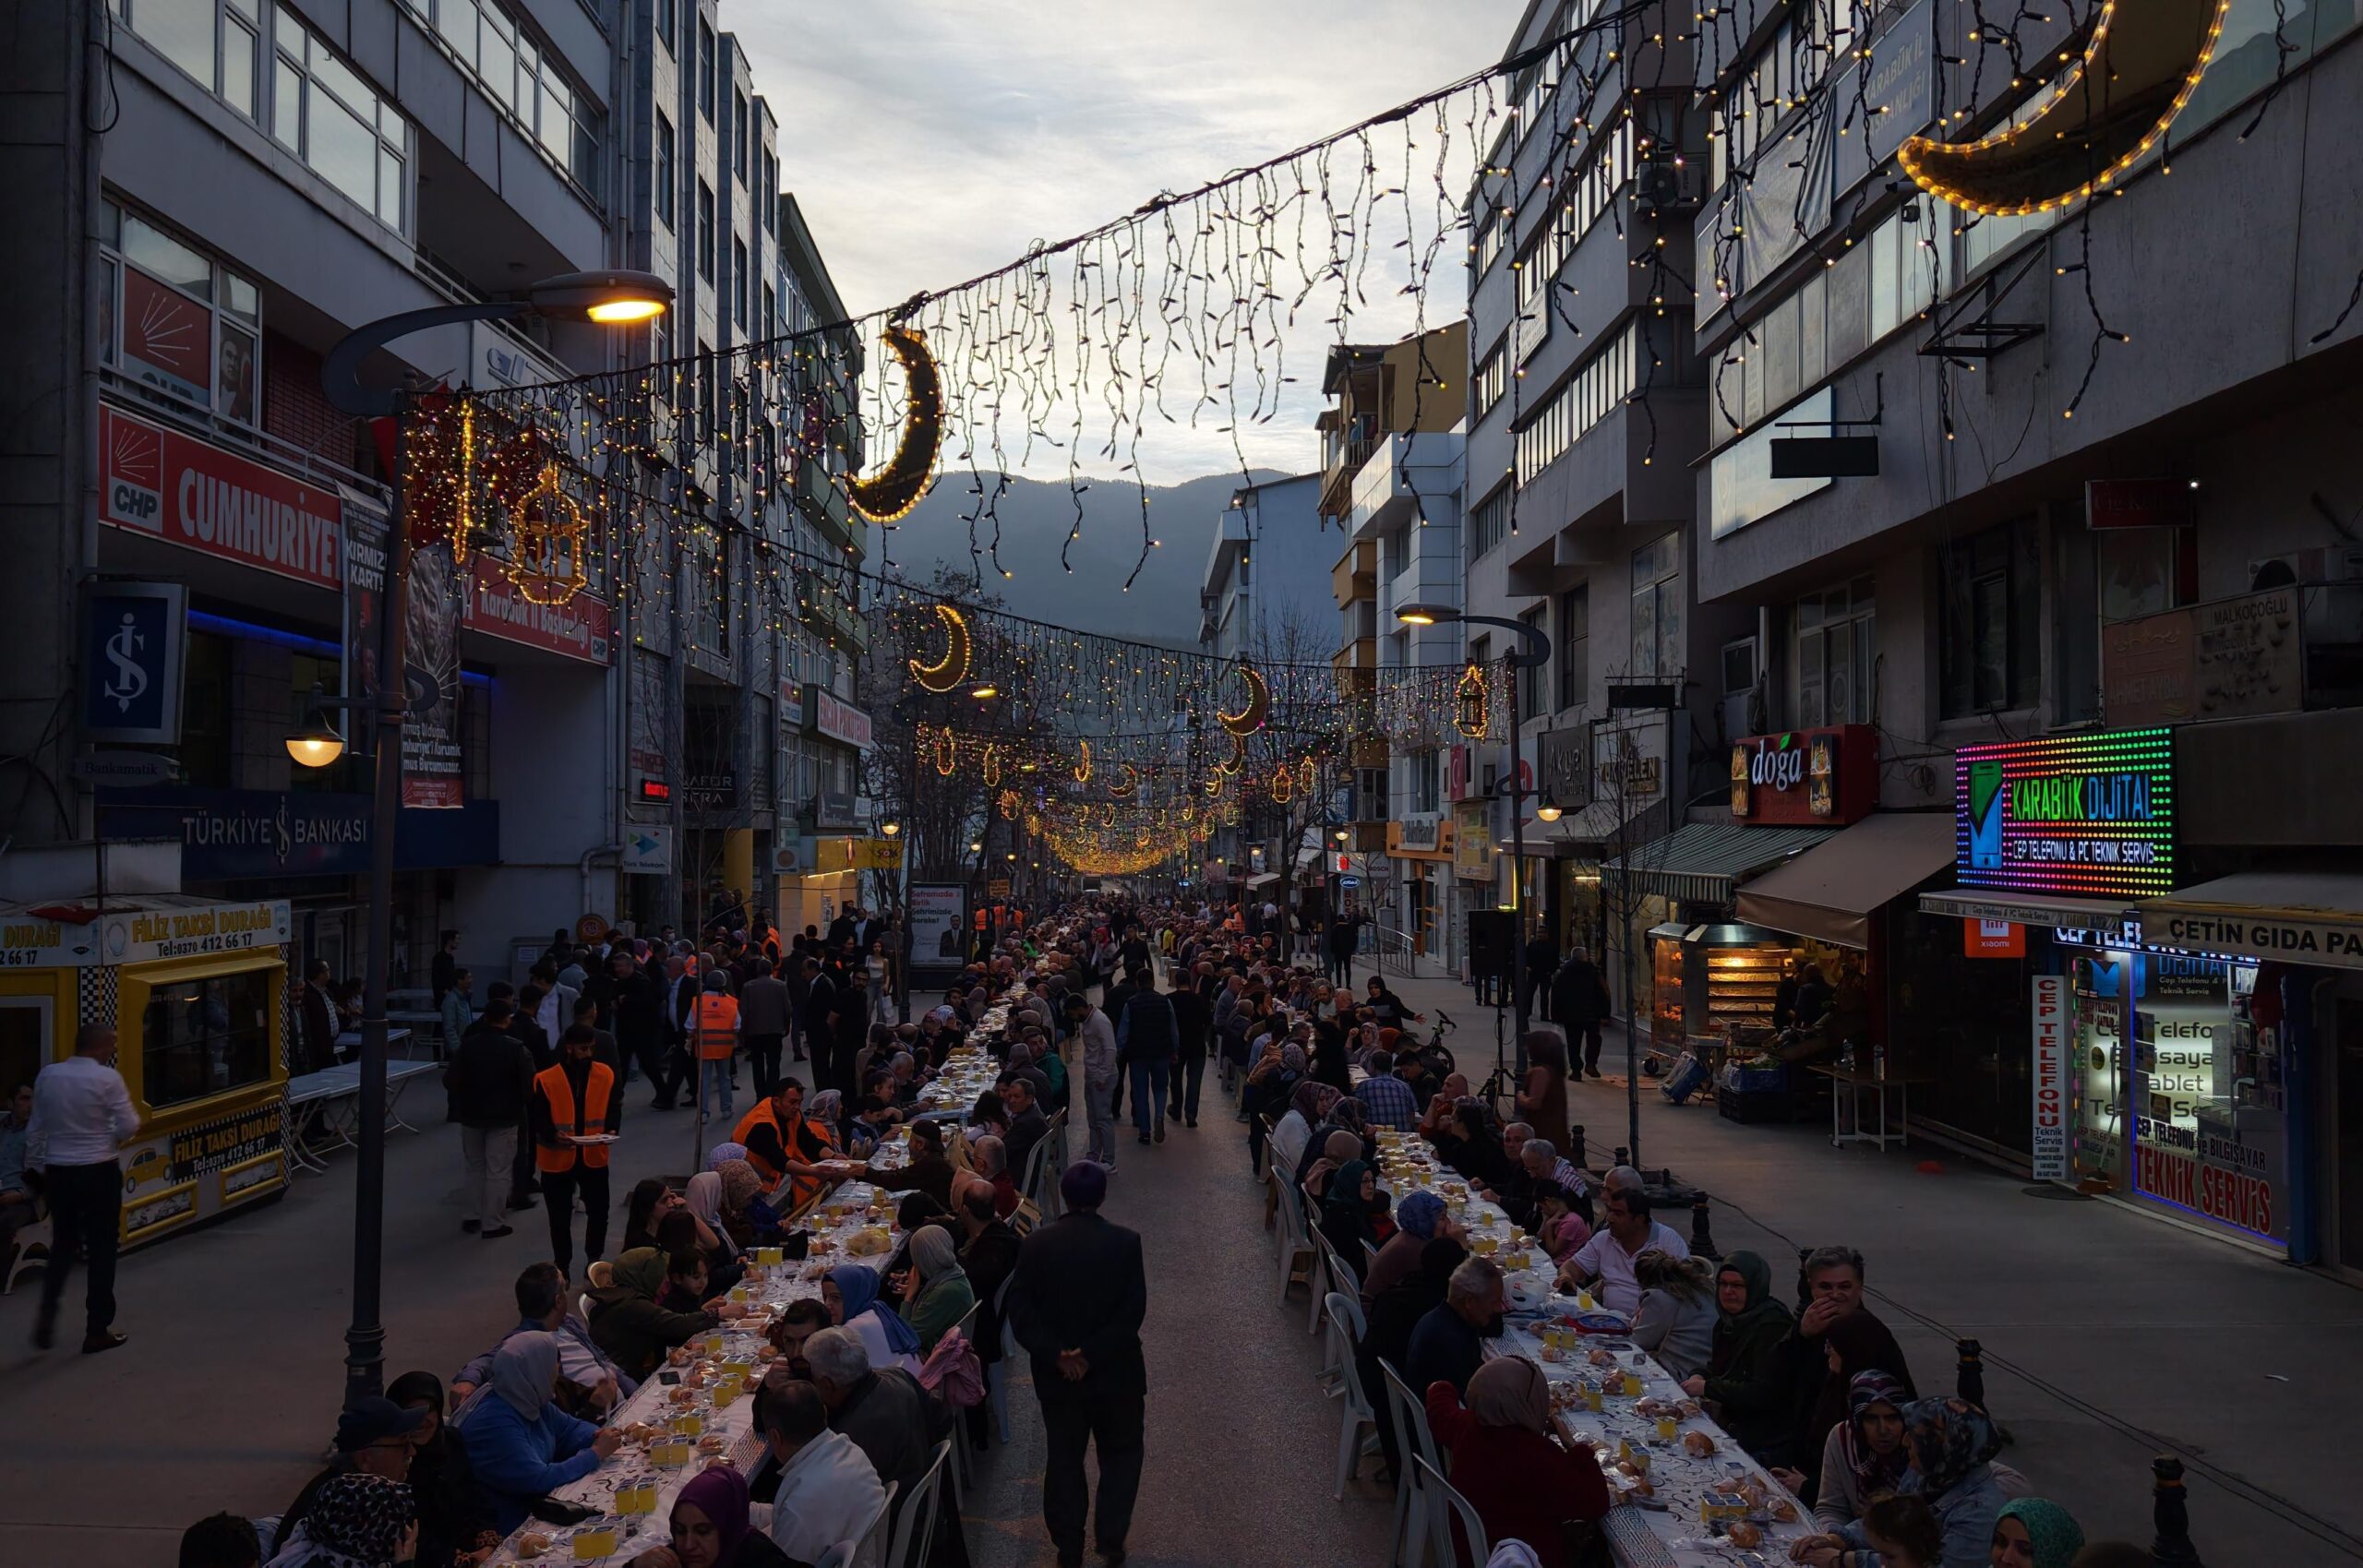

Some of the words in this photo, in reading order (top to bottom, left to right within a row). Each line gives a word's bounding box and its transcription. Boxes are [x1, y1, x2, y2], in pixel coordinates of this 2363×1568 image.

[114, 485, 157, 519] CHP
[178, 467, 342, 581] CUMHURİYET
[351, 564, 383, 593] KART!
[85, 762, 158, 776] Bankamatik
[1550, 738, 1585, 781] Akyel
[2013, 774, 2084, 820] KARABÜK
[2088, 774, 2154, 820] DİJİTAL
[183, 810, 271, 845] TÜRKİYE
[294, 818, 366, 844] BANKASI
[2013, 840, 2027, 859] CEP
[2029, 840, 2067, 860] TELEFONU
[2069, 841, 2075, 860] &
[2078, 841, 2089, 861] PC
[2091, 841, 2119, 862] TEKNİK
[2122, 842, 2154, 864] SERVİS
[132, 913, 170, 943] FİLİZ
[174, 908, 215, 939] TAKSİ
[220, 903, 271, 934] DURAĞI
[2170, 918, 2243, 944] ÇETİN
[2250, 926, 2318, 952] GIDA
[200, 936, 222, 952] 412
[225, 934, 238, 948] 66
[242, 932, 253, 946] 17
[1980, 940, 2009, 948] xiaomi
[8, 951, 22, 965] 66
[25, 950, 38, 964] 17
[2159, 987, 2184, 995] Teknik
[2177, 976, 2209, 985] Telefonu
[2038, 979, 2057, 1017] CEP
[2155, 1021, 2213, 1038] elefo
[2038, 1023, 2059, 1127] TELEFONU
[2149, 1074, 2204, 1092] ablet
[174, 1134, 204, 1165] FİLİZ
[206, 1122, 238, 1153] TAKSİ
[241, 1108, 281, 1143] DURAĞI
[2035, 1127, 2063, 1136] Teknik
[2035, 1136, 2063, 1145] Servis
[2135, 1117, 2152, 1139] CEP
[2153, 1121, 2195, 1152] TELEFONU
[2196, 1140, 2207, 1154] ve
[2210, 1134, 2266, 1171] BİLGİSAYAR
[227, 1146, 243, 1161] 412
[245, 1142, 255, 1154] 66
[257, 1137, 266, 1149] 17
[2133, 1143, 2196, 1207] TEKNİK
[2201, 1163, 2271, 1235] SERVİS
